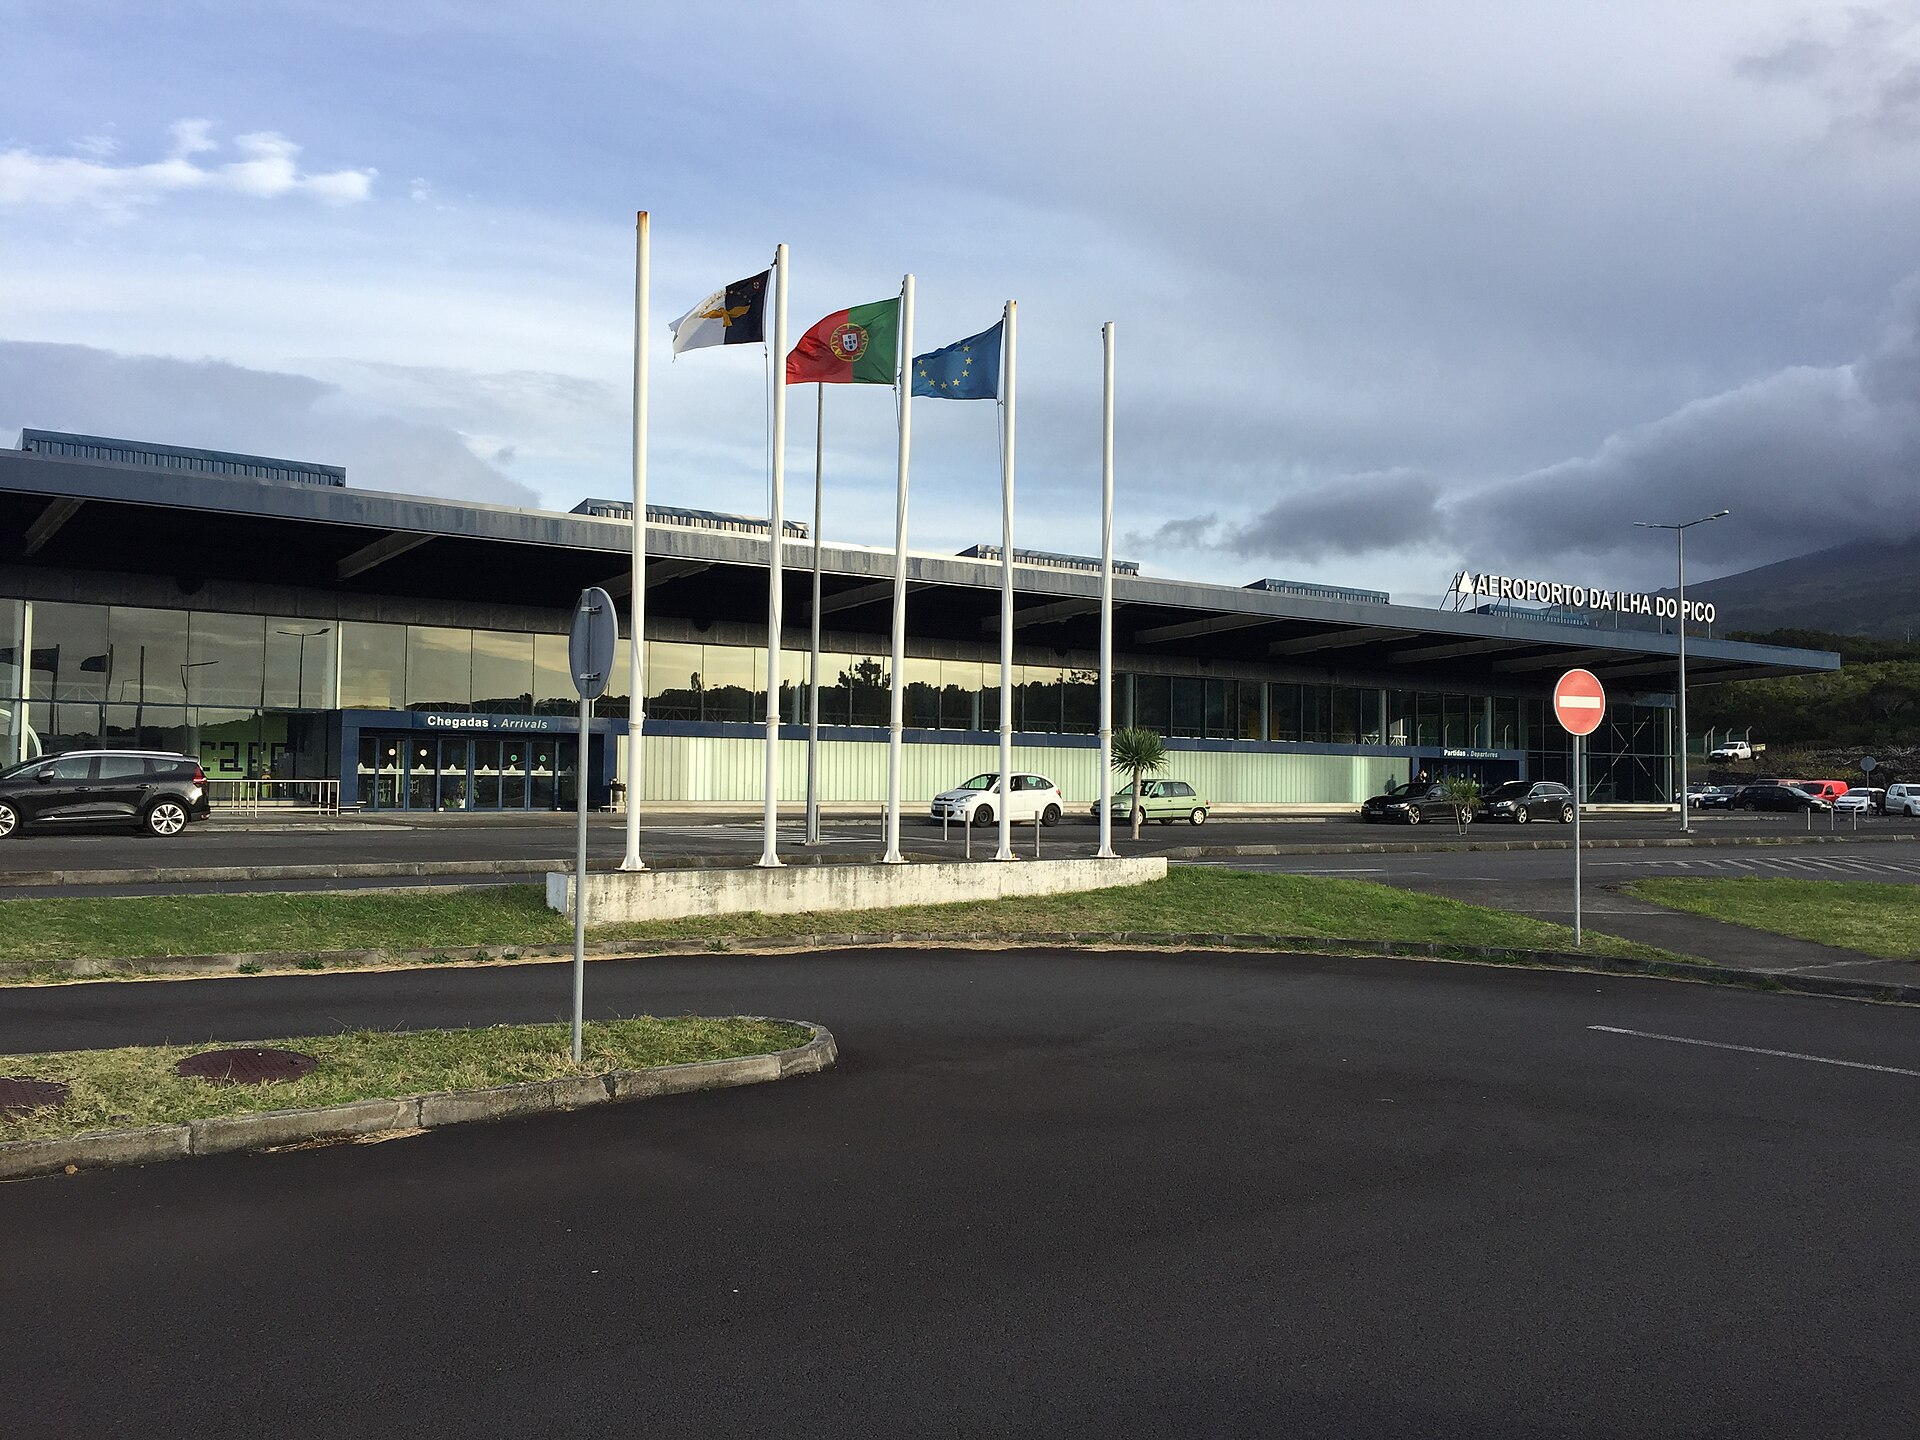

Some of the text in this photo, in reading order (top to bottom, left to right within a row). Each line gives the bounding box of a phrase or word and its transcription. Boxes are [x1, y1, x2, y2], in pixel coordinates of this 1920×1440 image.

[1475, 573, 1716, 623] AEROPORTO DA ILHA DO PICO
[427, 715, 548, 729] Chegadas Arrivals
[1443, 749, 1498, 758] Partidas Departures
